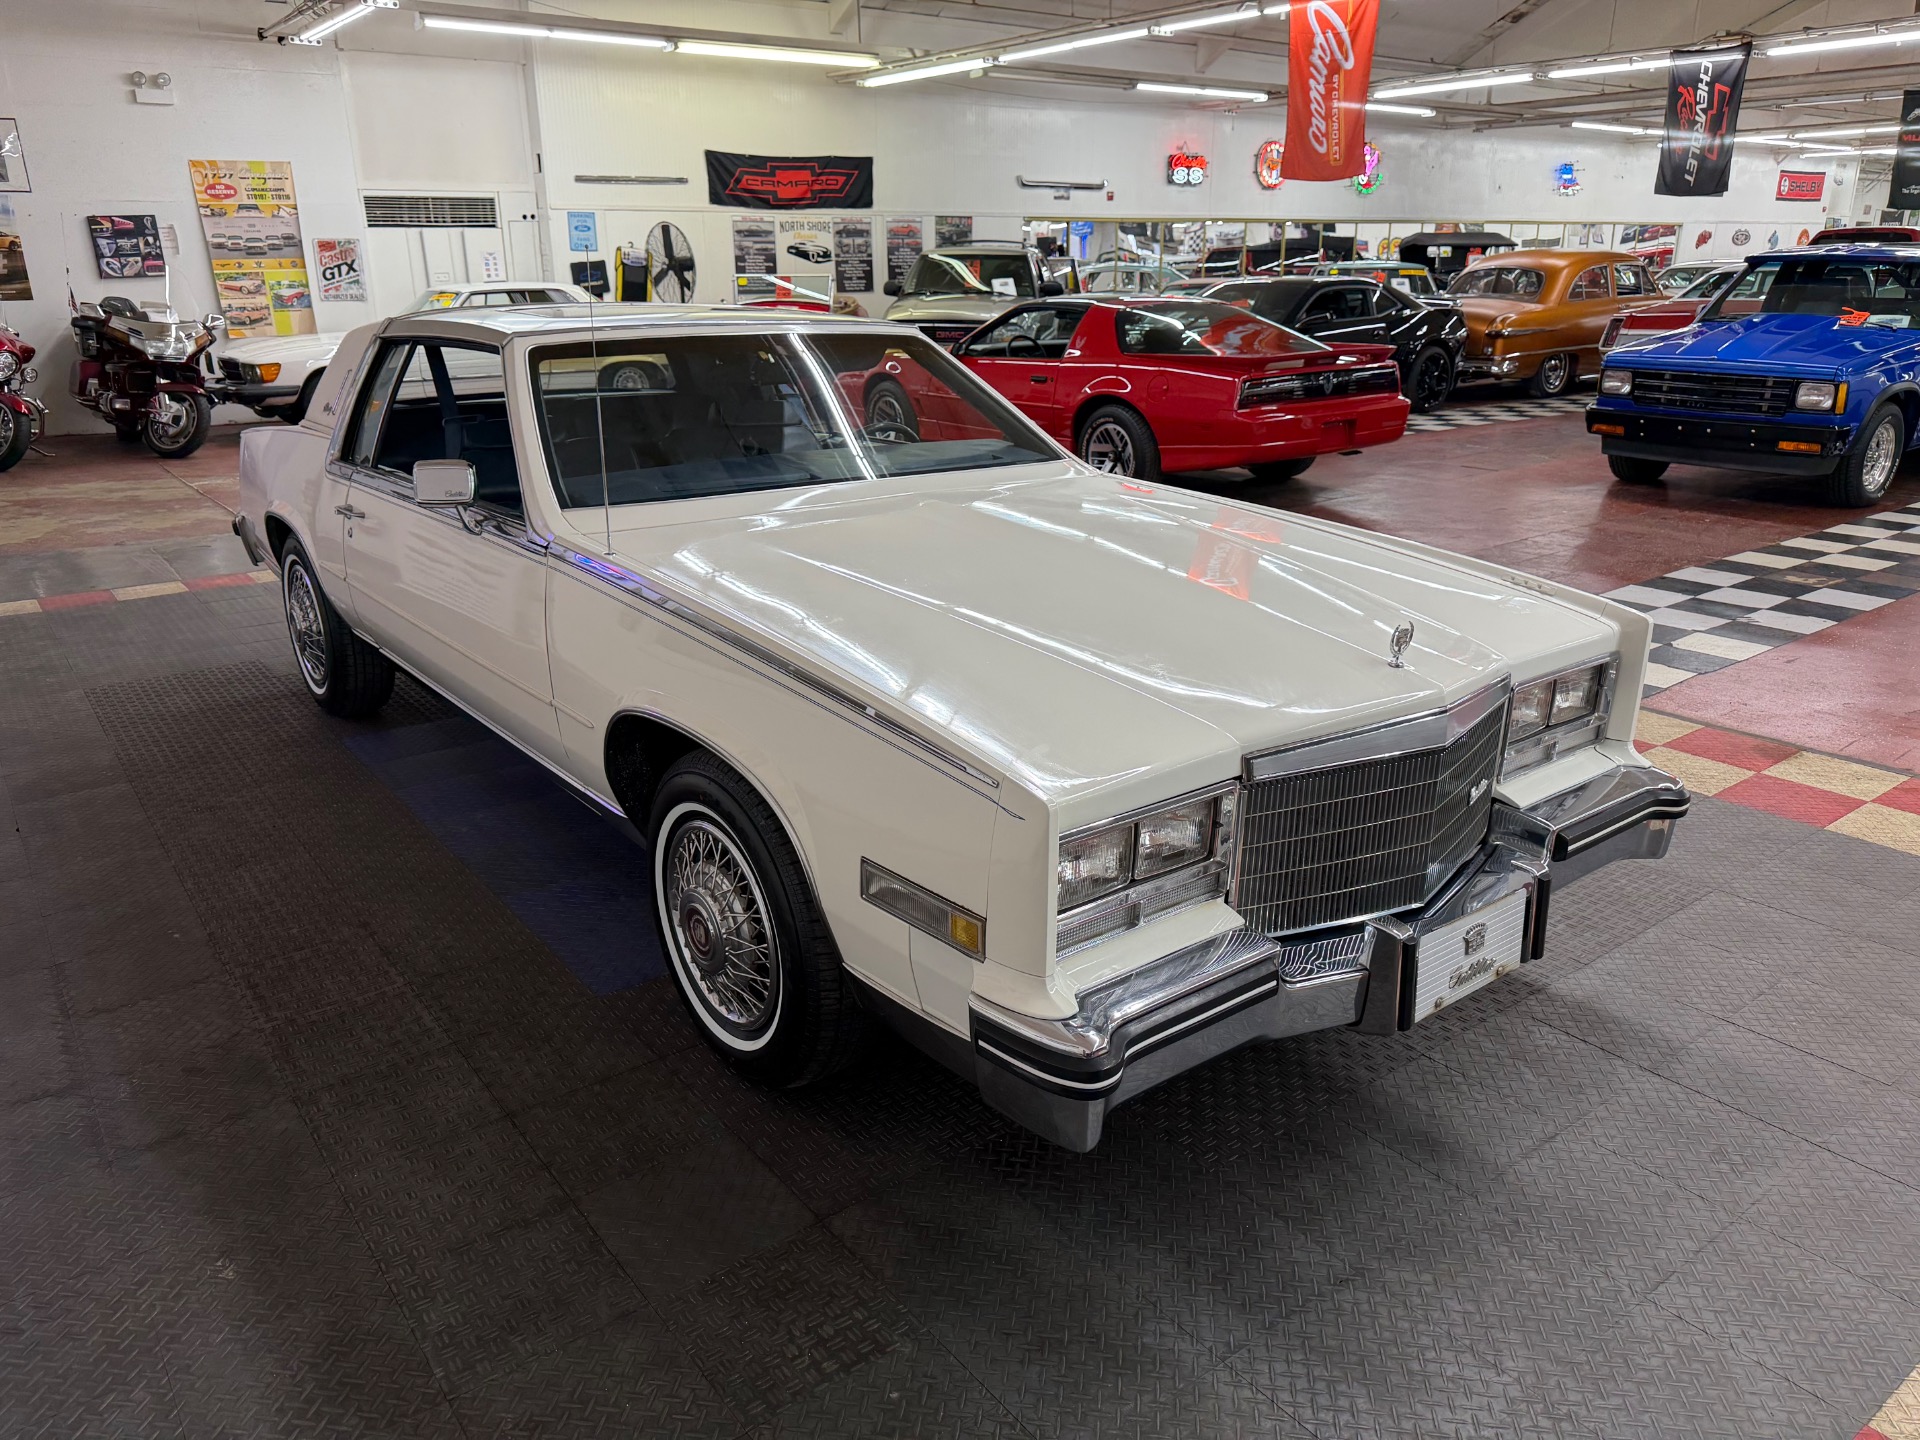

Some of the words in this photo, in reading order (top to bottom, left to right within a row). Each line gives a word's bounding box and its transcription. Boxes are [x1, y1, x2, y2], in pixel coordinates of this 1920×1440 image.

[1307, 1, 1355, 154] Camaro
[1332, 74, 1339, 88] BY
[1331, 91, 1340, 160] CHEVROLET
[1684, 60, 1713, 187] CHEVROLET
[745, 178, 839, 188] CAMARO
[1172, 166, 1204, 184] SS
[1789, 180, 1823, 192] SHELBY
[780, 221, 806, 233] NORTH
[806, 221, 832, 234] SHORE
[322, 259, 358, 282] GTX
[935, 331, 965, 339] GMC
[1448, 956, 1498, 990] Cadillac
